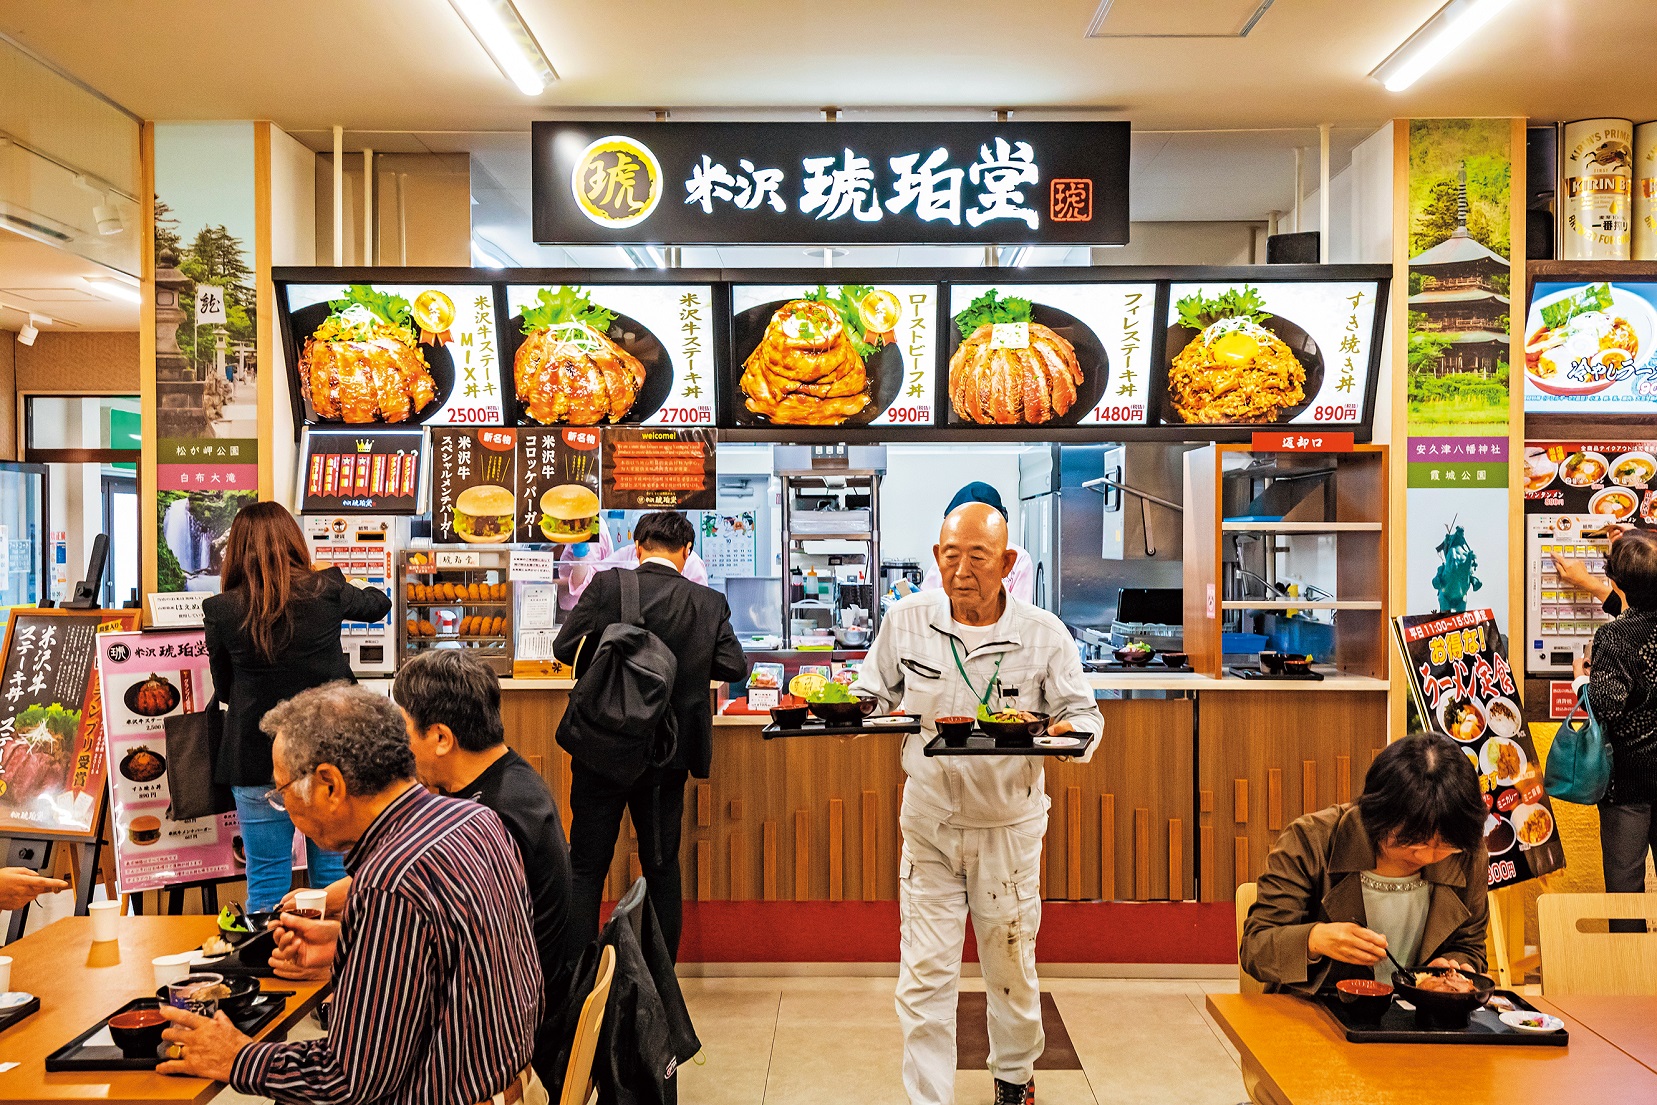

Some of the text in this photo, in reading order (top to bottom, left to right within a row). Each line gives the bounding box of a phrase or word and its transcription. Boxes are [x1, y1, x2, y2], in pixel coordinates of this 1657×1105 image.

[584, 152, 646, 212] 琥
[684, 137, 1040, 231] 米沢 琥珀堂
[1572, 178, 1616, 193] KIRIN
[1592, 220, 1628, 232] 一番搾り
[474, 295, 498, 396] 米沢牛ステーキ
[679, 292, 703, 399] 米沢牛ステーキ丼
[906, 293, 928, 399] ローストビーフ丼
[1116, 293, 1143, 397] フィレステーキ丼
[1335, 291, 1365, 394] すき焼き丼
[447, 407, 499, 423] 2500円
[659, 407, 711, 423] 2700円
[888, 406, 929, 423] 990円
[1094, 406, 1143, 422] 1480円
[1314, 405, 1357, 421] 890円
[483, 432, 512, 445] 新名物
[567, 431, 596, 445] 新名物
[642, 431, 677, 440] welcome!
[1282, 436, 1323, 450] 返却口
[176, 445, 240, 456] 松が岬公園
[457, 435, 471, 480] 米沢牛
[541, 434, 555, 480] 米沢牛
[1416, 444, 1501, 455] 安久津八幡神社
[180, 472, 236, 483] 白布大滝
[1430, 469, 1487, 481] 霞城公園
[440, 436, 453, 540] スペシャルメンチバーガー
[523, 435, 537, 538] コロッケバーガー
[135, 640, 210, 658] 米沢 琥珀堂
[27, 624, 57, 697] 米沢牛
[1419, 652, 1516, 710] ラーメン定食
[1497, 792, 1519, 809] ミニカレー
